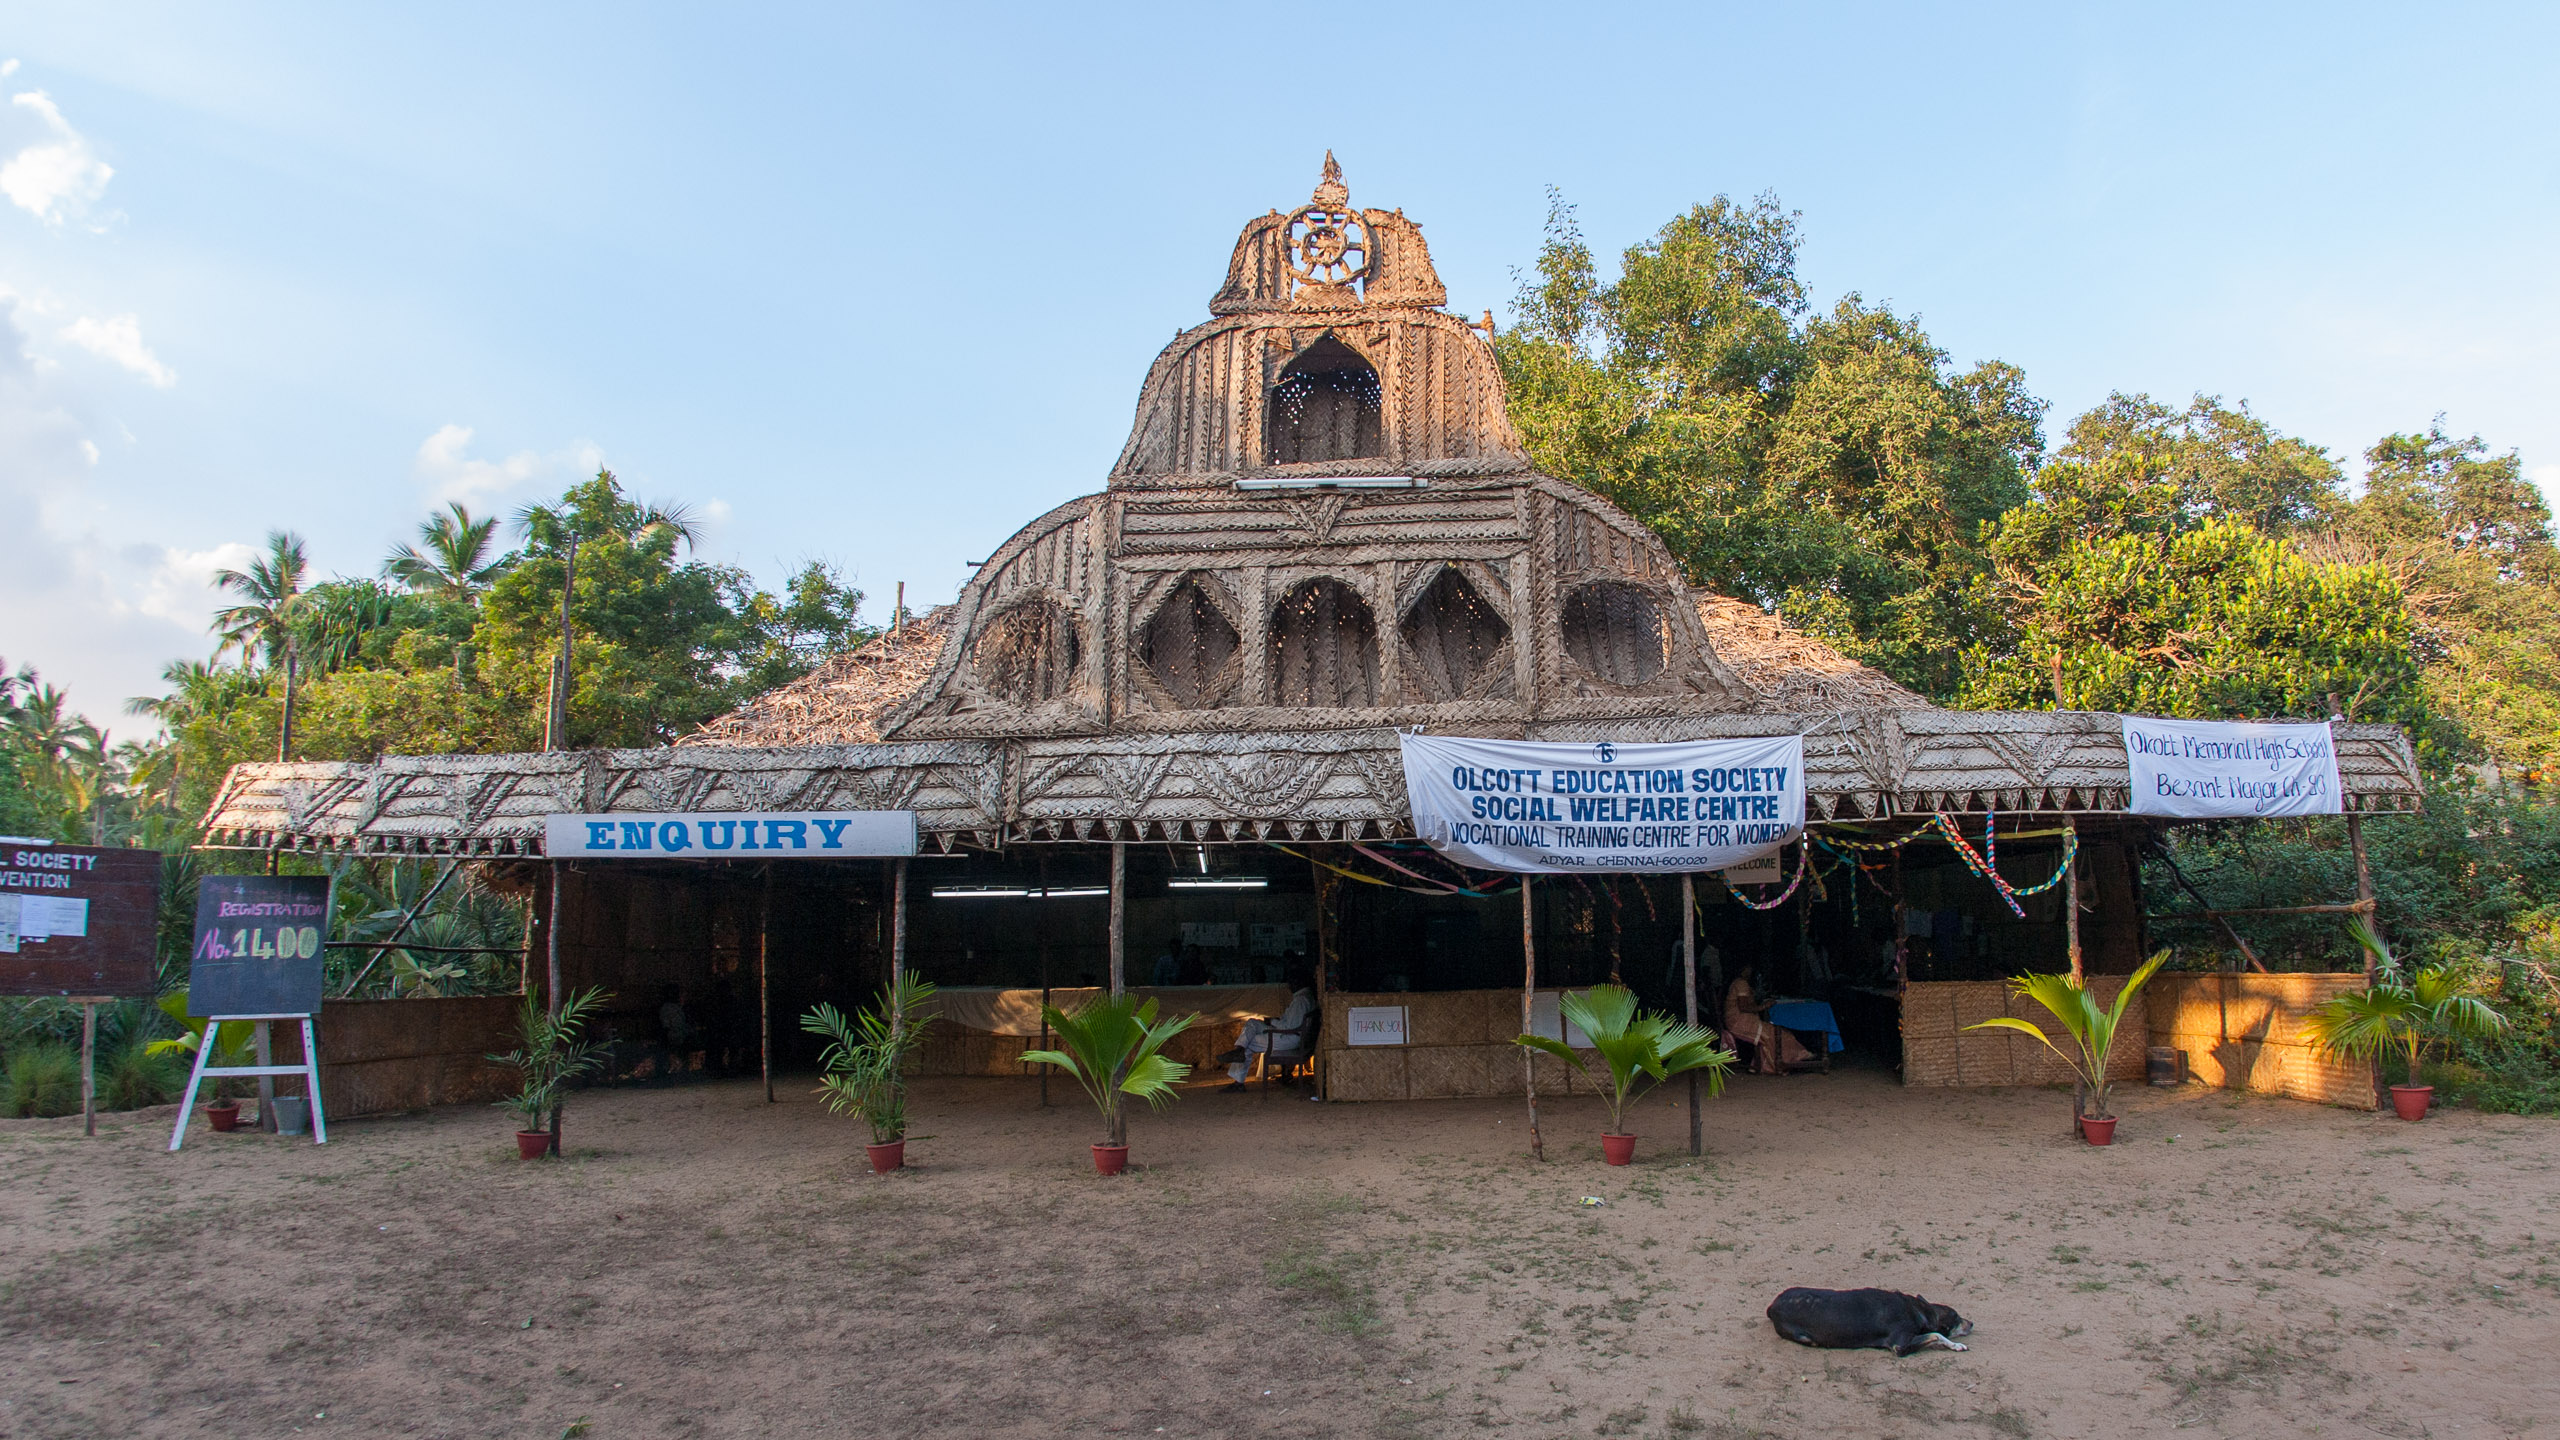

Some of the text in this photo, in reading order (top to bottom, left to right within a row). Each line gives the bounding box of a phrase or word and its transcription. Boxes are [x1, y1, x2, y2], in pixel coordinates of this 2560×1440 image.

[2130, 731, 2329, 771] Olcott Memorial High School
[1453, 767, 1787, 794] OLCOTT EDUCATION SOCIETY
[2229, 777, 2276, 812] Nagar
[1472, 796, 1779, 823] SOCIAL WELFARE CENTRE
[585, 819, 853, 853] ENQUIRY
[1555, 826, 1628, 849] TRAINING
[1633, 825, 1690, 848] CENTRE
[1697, 825, 1730, 848] FOR
[1736, 823, 1790, 845] WOMEN
[15, 851, 98, 871] SOCIETY
[1728, 857, 1777, 870] ELCOME
[218, 901, 325, 918] REGISTRATION
[232, 926, 319, 960] 1400
[1355, 1020, 1385, 1033] THANK
